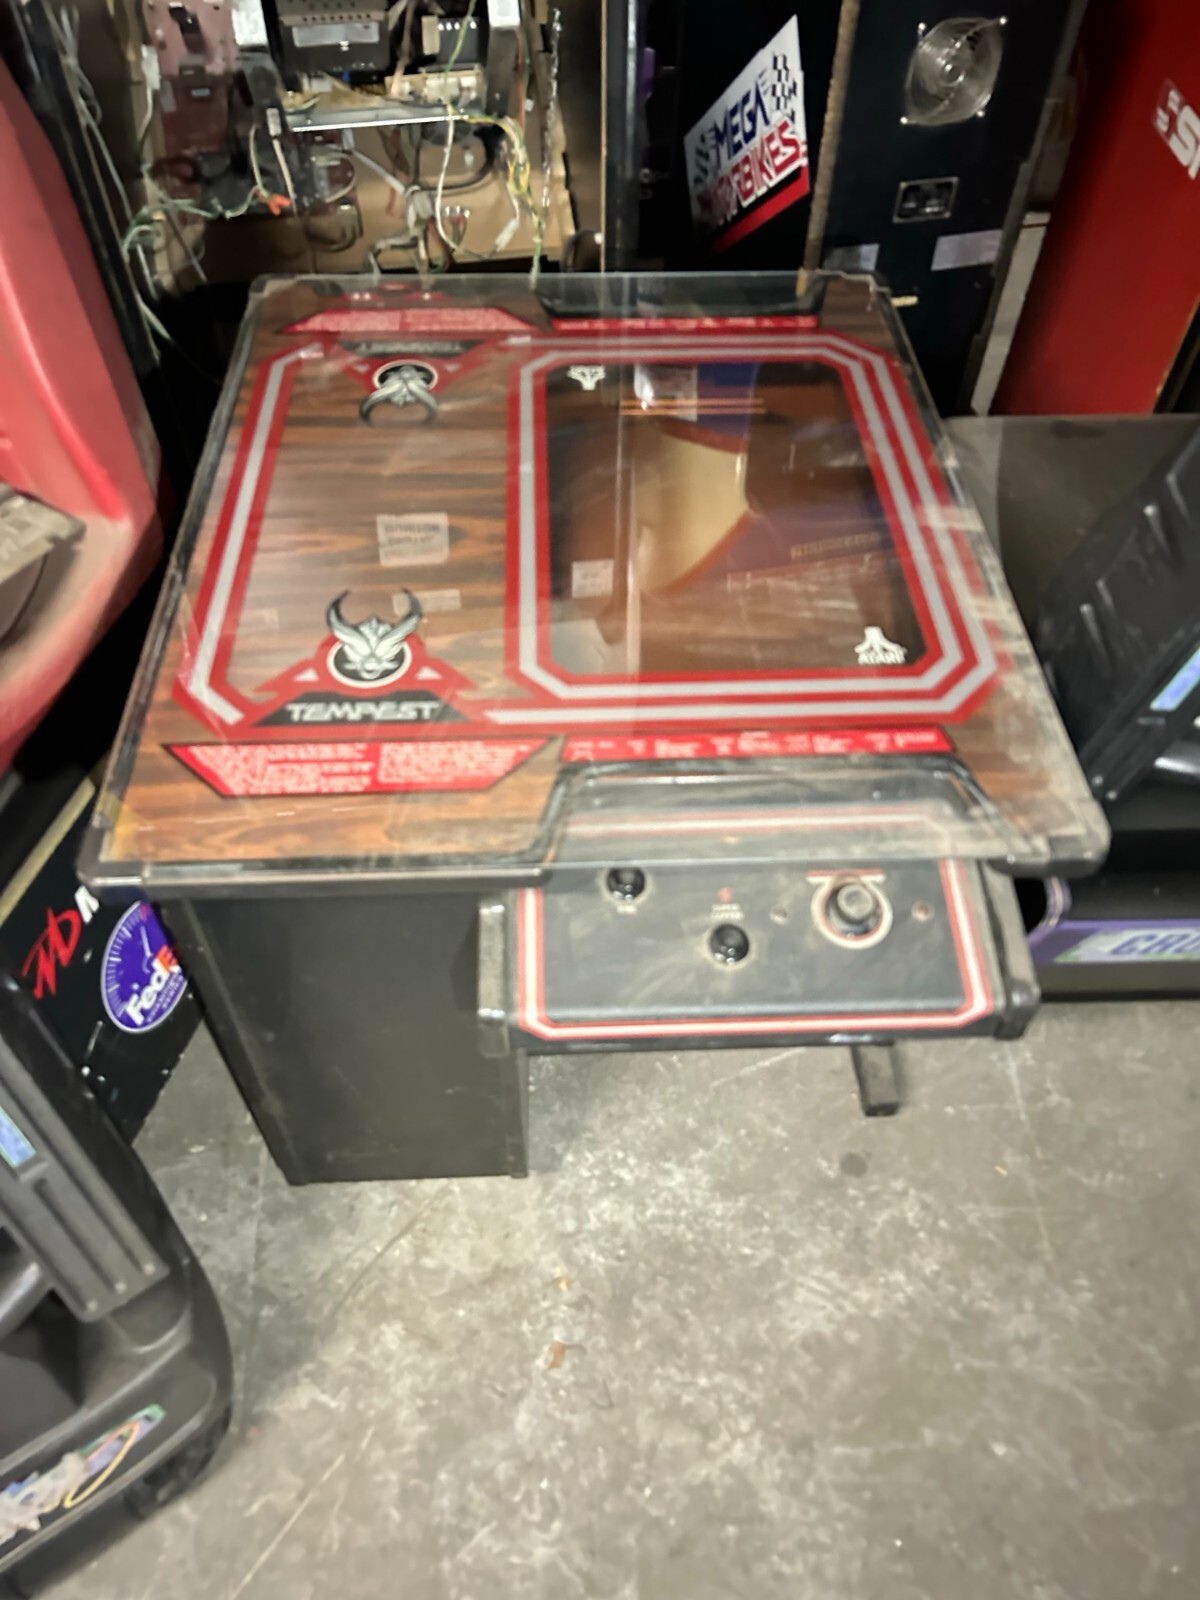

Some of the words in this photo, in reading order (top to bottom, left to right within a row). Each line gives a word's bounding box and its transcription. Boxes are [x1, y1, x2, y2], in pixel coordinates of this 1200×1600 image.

[711, 80, 771, 170] MEGA
[857, 650, 906, 665] ATARI
[286, 701, 441, 722] TEMPEST
